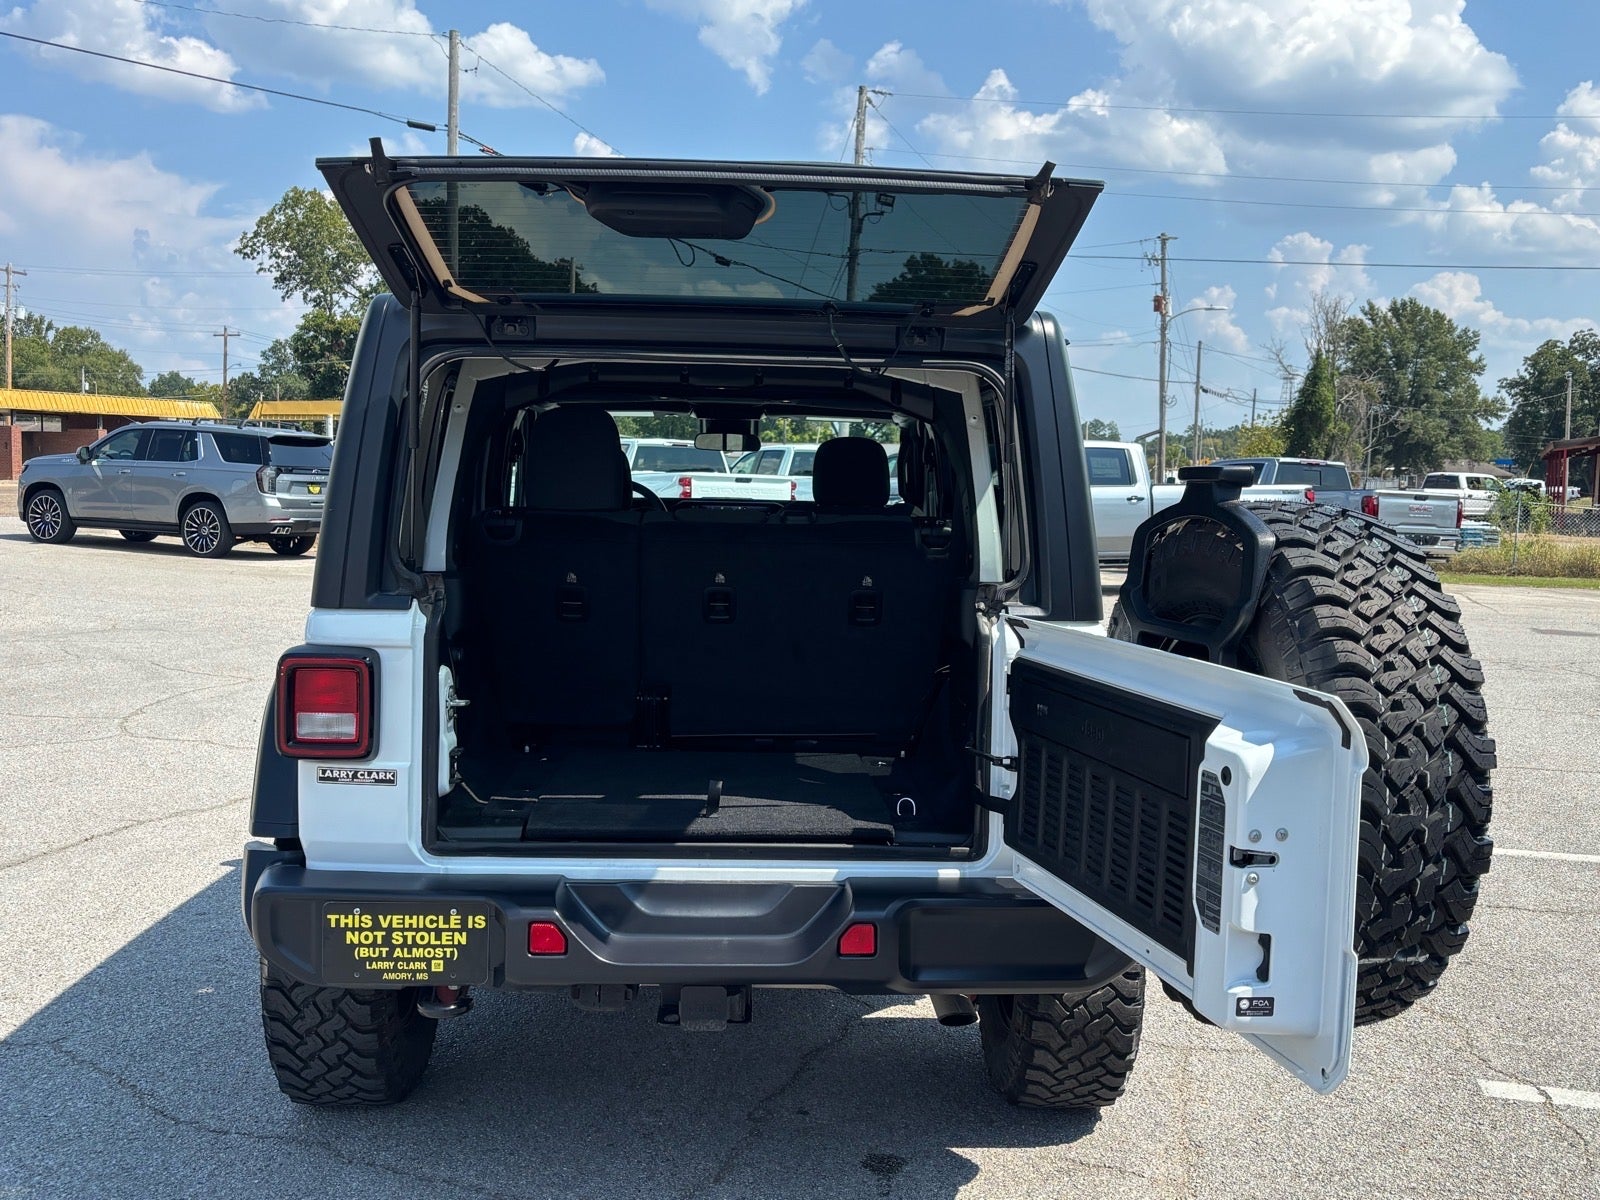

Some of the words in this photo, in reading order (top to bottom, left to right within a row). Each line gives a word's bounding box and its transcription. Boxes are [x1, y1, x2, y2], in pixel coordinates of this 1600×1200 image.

[1408, 504, 1434, 513] GMC
[319, 769, 354, 778] LARRY
[357, 771, 395, 780] CLARK
[326, 914, 373, 928] THIS
[378, 914, 462, 929] VEHICLE
[467, 915, 487, 929] IS
[345, 931, 386, 945] NOT
[391, 931, 467, 945] STOLEN
[354, 947, 389, 960] (BUT
[393, 947, 458, 961] ALMOST)
[366, 961, 394, 970] LARRY
[397, 961, 427, 970] CLARK
[416, 972, 429, 981] MS
[1252, 999, 1270, 1007] FCA
